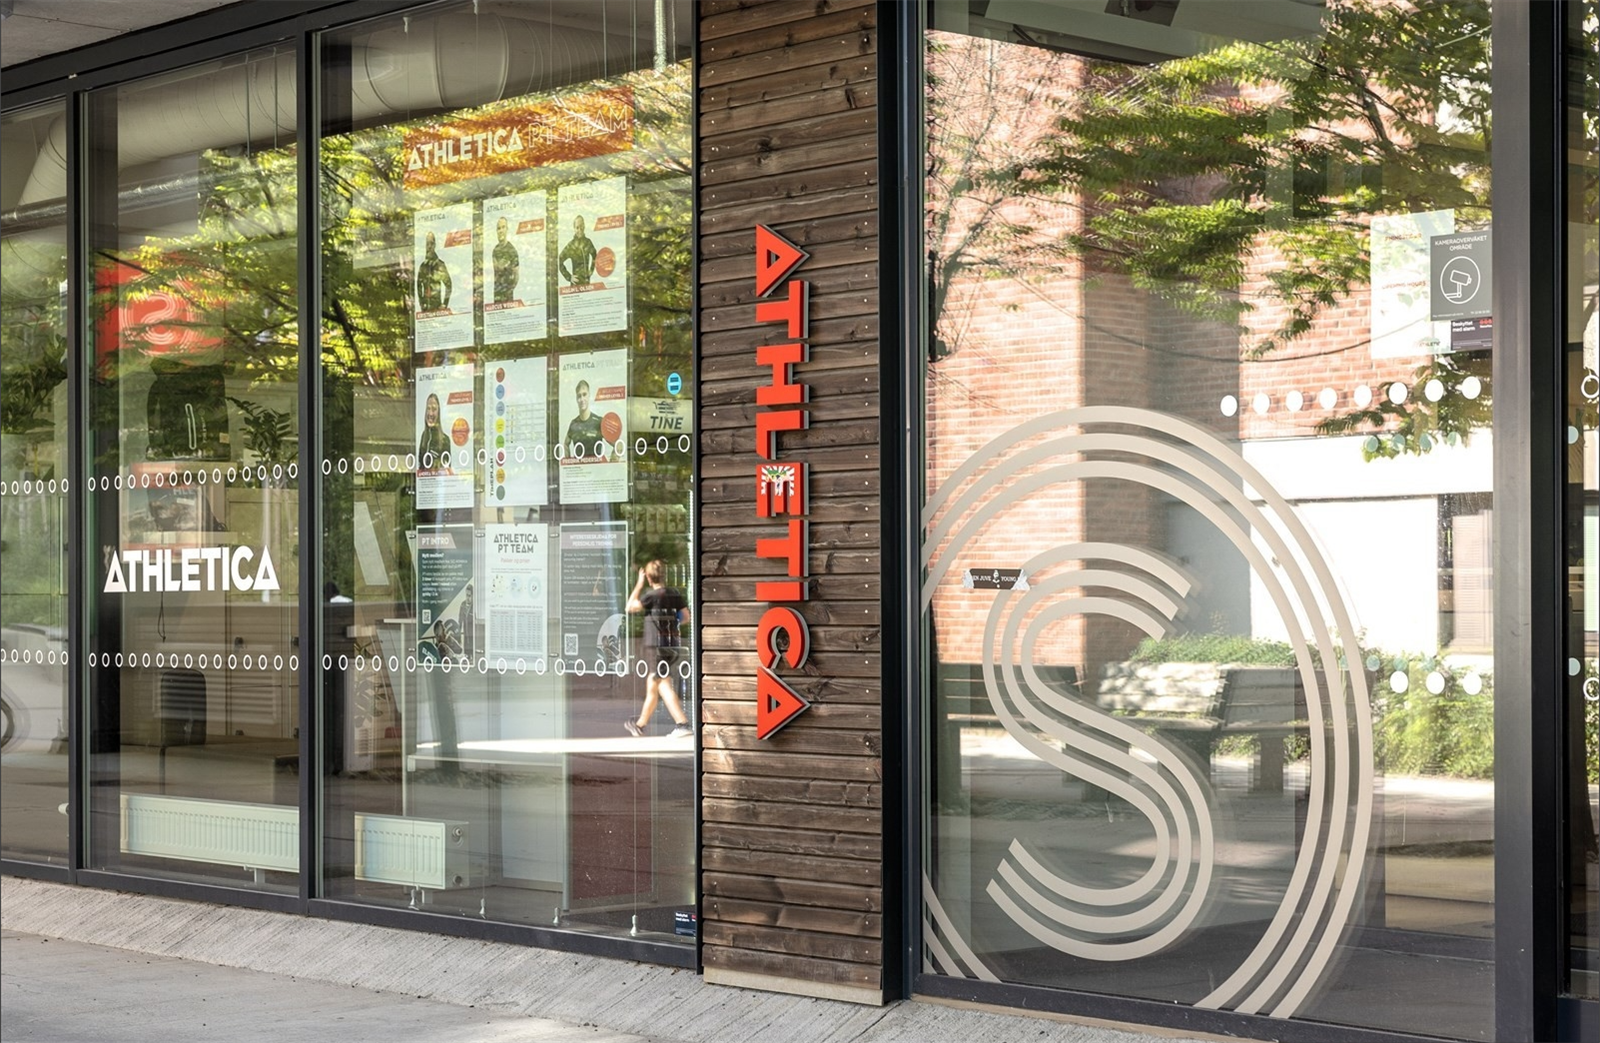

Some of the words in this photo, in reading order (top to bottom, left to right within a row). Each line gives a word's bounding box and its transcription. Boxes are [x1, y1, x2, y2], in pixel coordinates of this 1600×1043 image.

[408, 126, 524, 171] ATHLETICA
[528, 115, 558, 148] PT
[562, 103, 628, 142] TEAM
[562, 361, 595, 371] ATHLETICA
[650, 415, 684, 430] TINE
[756, 223, 810, 741] ATHLETICA
[422, 537, 430, 545] PT
[430, 537, 450, 545] INTRO
[493, 533, 539, 543] ATHLETICA
[497, 543, 509, 554] PT
[510, 543, 535, 554] TEAM
[103, 544, 280, 593] ATHLETICA
